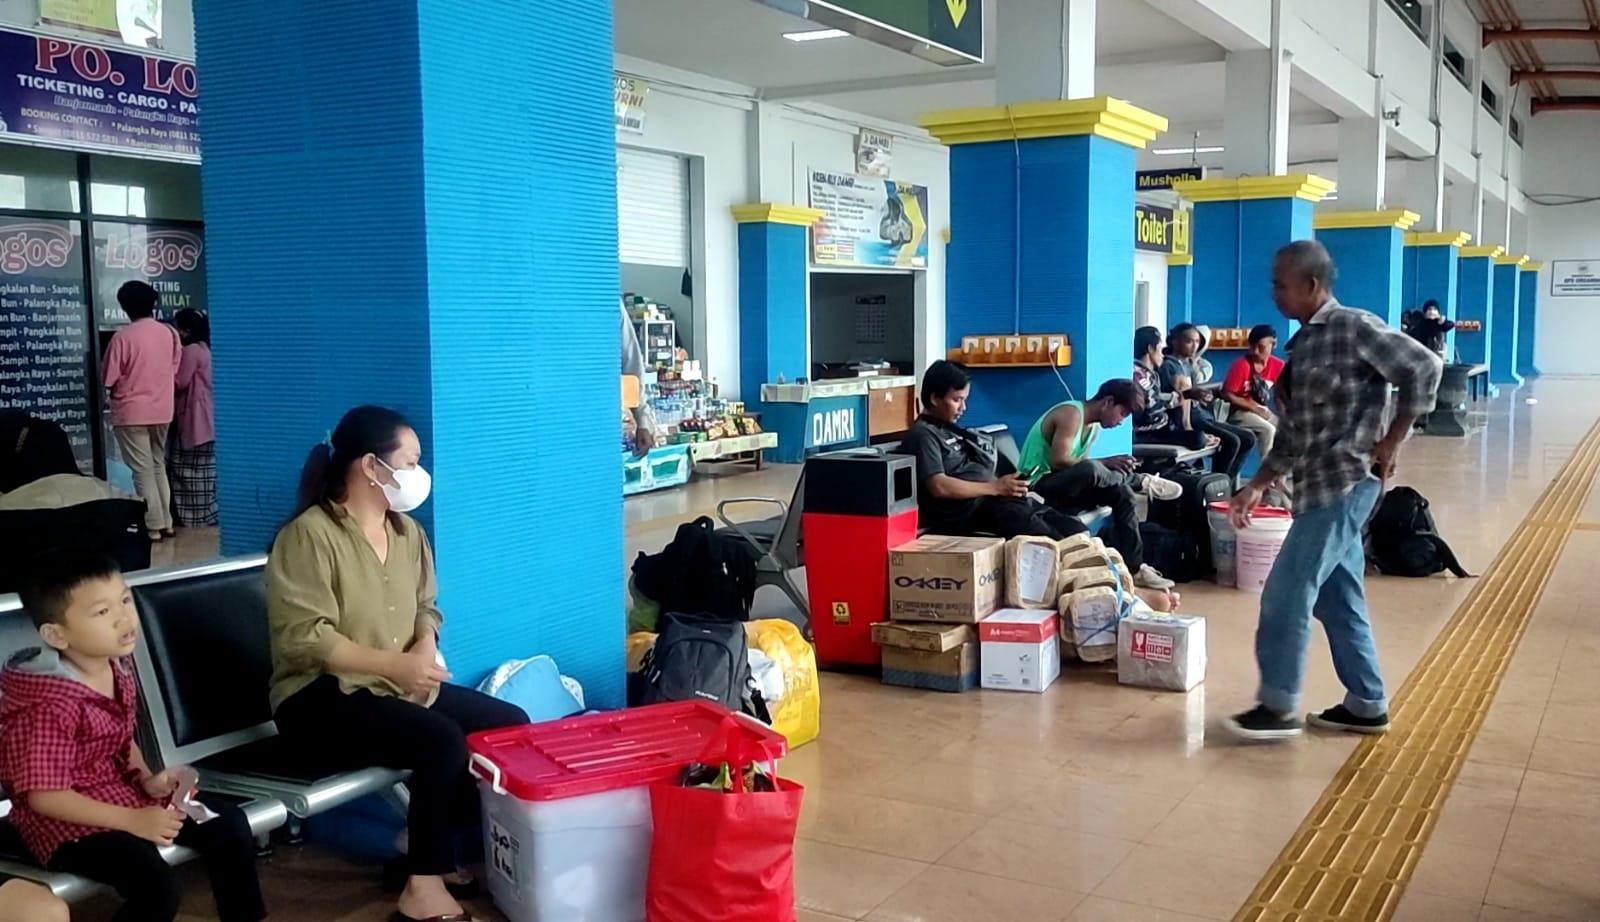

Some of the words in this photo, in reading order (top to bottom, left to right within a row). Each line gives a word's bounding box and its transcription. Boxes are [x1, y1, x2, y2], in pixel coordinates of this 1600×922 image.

[35, 36, 125, 86] PO.
[16, 73, 105, 99] TICKETING
[117, 91, 168, 109] CARGO
[21, 107, 60, 121] BOOKING
[61, 113, 98, 127] CONTACT
[117, 122, 150, 136] Palangka
[150, 127, 168, 138] Raya
[1139, 172, 1197, 187] Musholla
[1136, 209, 1168, 246] Toilet
[105, 233, 199, 277] Logos
[30, 284, 46, 294] Bun
[52, 284, 80, 296] Sampit
[150, 281, 181, 292] ETING
[24, 299, 60, 310] Palangka
[61, 298, 81, 310] Raya
[161, 293, 191, 306] KILAT
[10, 313, 27, 322] Bun
[33, 312, 81, 324] Banjarmasin
[24, 326, 65, 338] Pangkalan
[66, 326, 82, 336] Bun
[26, 340, 63, 353] Palangka
[63, 340, 82, 351] Raya
[0, 356, 29, 367] Sampit
[35, 355, 84, 366] Banjarmasin
[31, 369, 51, 380] Raya
[56, 367, 85, 379] Sampit
[1, 385, 21, 395] Raya
[27, 383, 68, 394] Pangkalan
[69, 381, 85, 391] Bun
[11, 398, 32, 410] Raya
[37, 397, 86, 407] Banjarmasin
[67, 409, 86, 419] Raya
[812, 407, 855, 446] DAMRI
